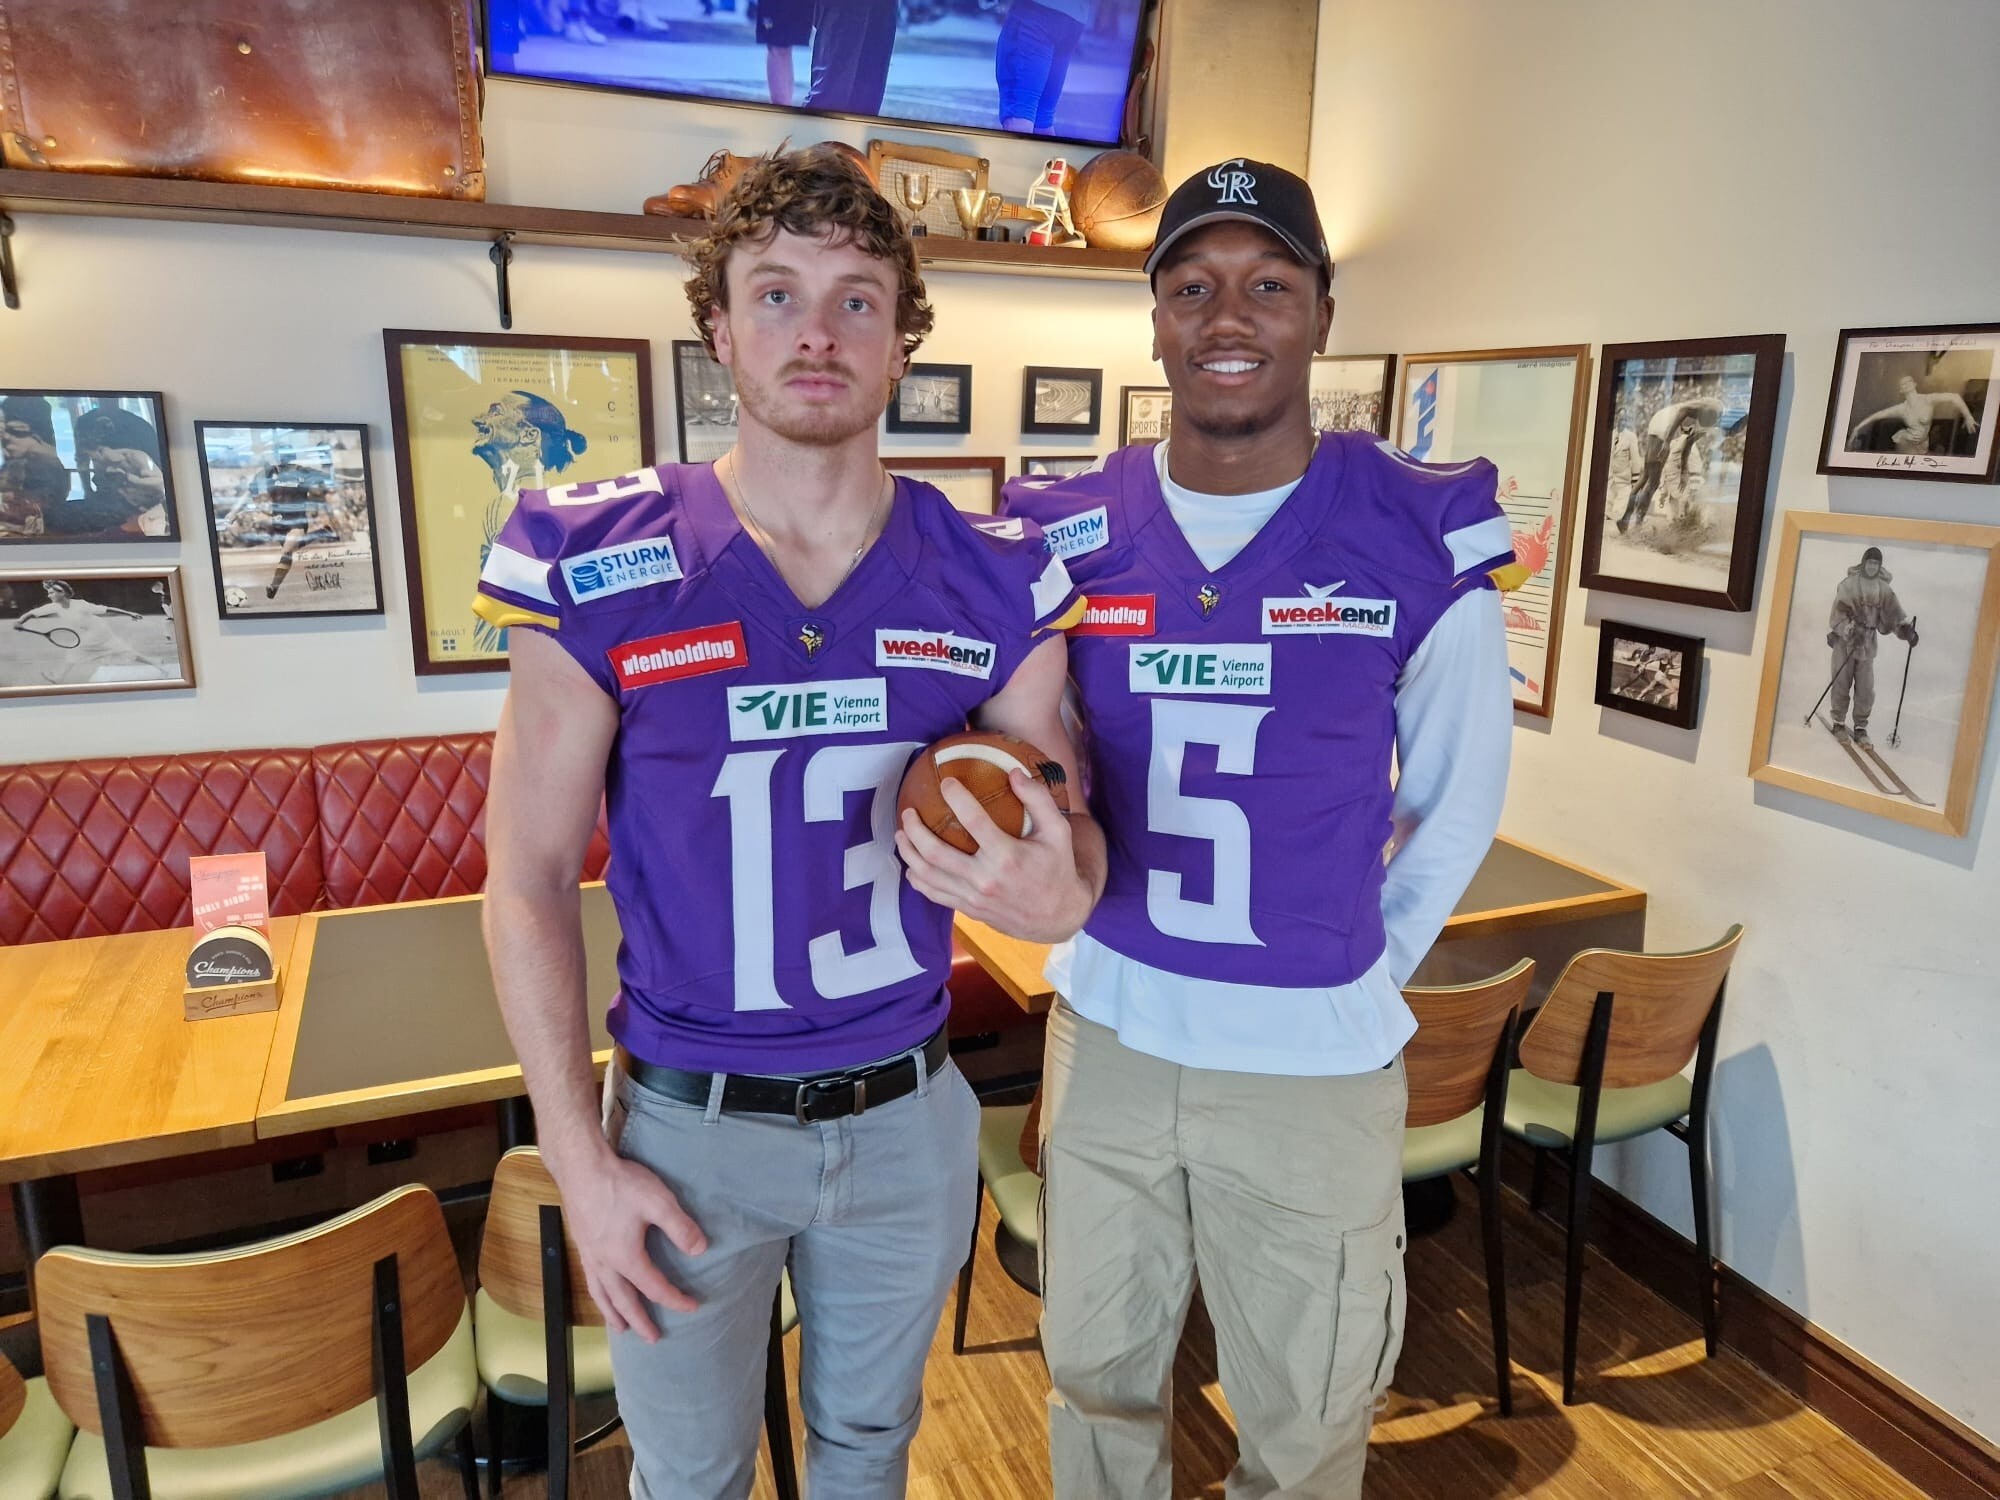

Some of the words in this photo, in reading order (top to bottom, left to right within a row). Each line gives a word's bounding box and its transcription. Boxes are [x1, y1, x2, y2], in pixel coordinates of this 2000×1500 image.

[1130, 420, 1159, 435] SPORTS
[1049, 515, 1104, 544] STURM
[602, 545, 671, 573] STURM
[606, 561, 676, 587] ENERGIE
[1268, 602, 1391, 625] weekend
[1342, 622, 1384, 632] MAGAZIN
[882, 638, 991, 668] weekend
[950, 661, 983, 673] MAGAZIN
[1155, 654, 1218, 686] VIE
[1222, 660, 1265, 672] Vienna
[1220, 674, 1265, 689] Airport
[762, 691, 828, 731] VIE
[833, 696, 880, 709] Vienna
[833, 711, 881, 727] Airport
[1146, 698, 1276, 948] 5
[710, 741, 928, 1012] 13
[194, 960, 261, 982] Champions
[201, 992, 264, 1011] Champions
